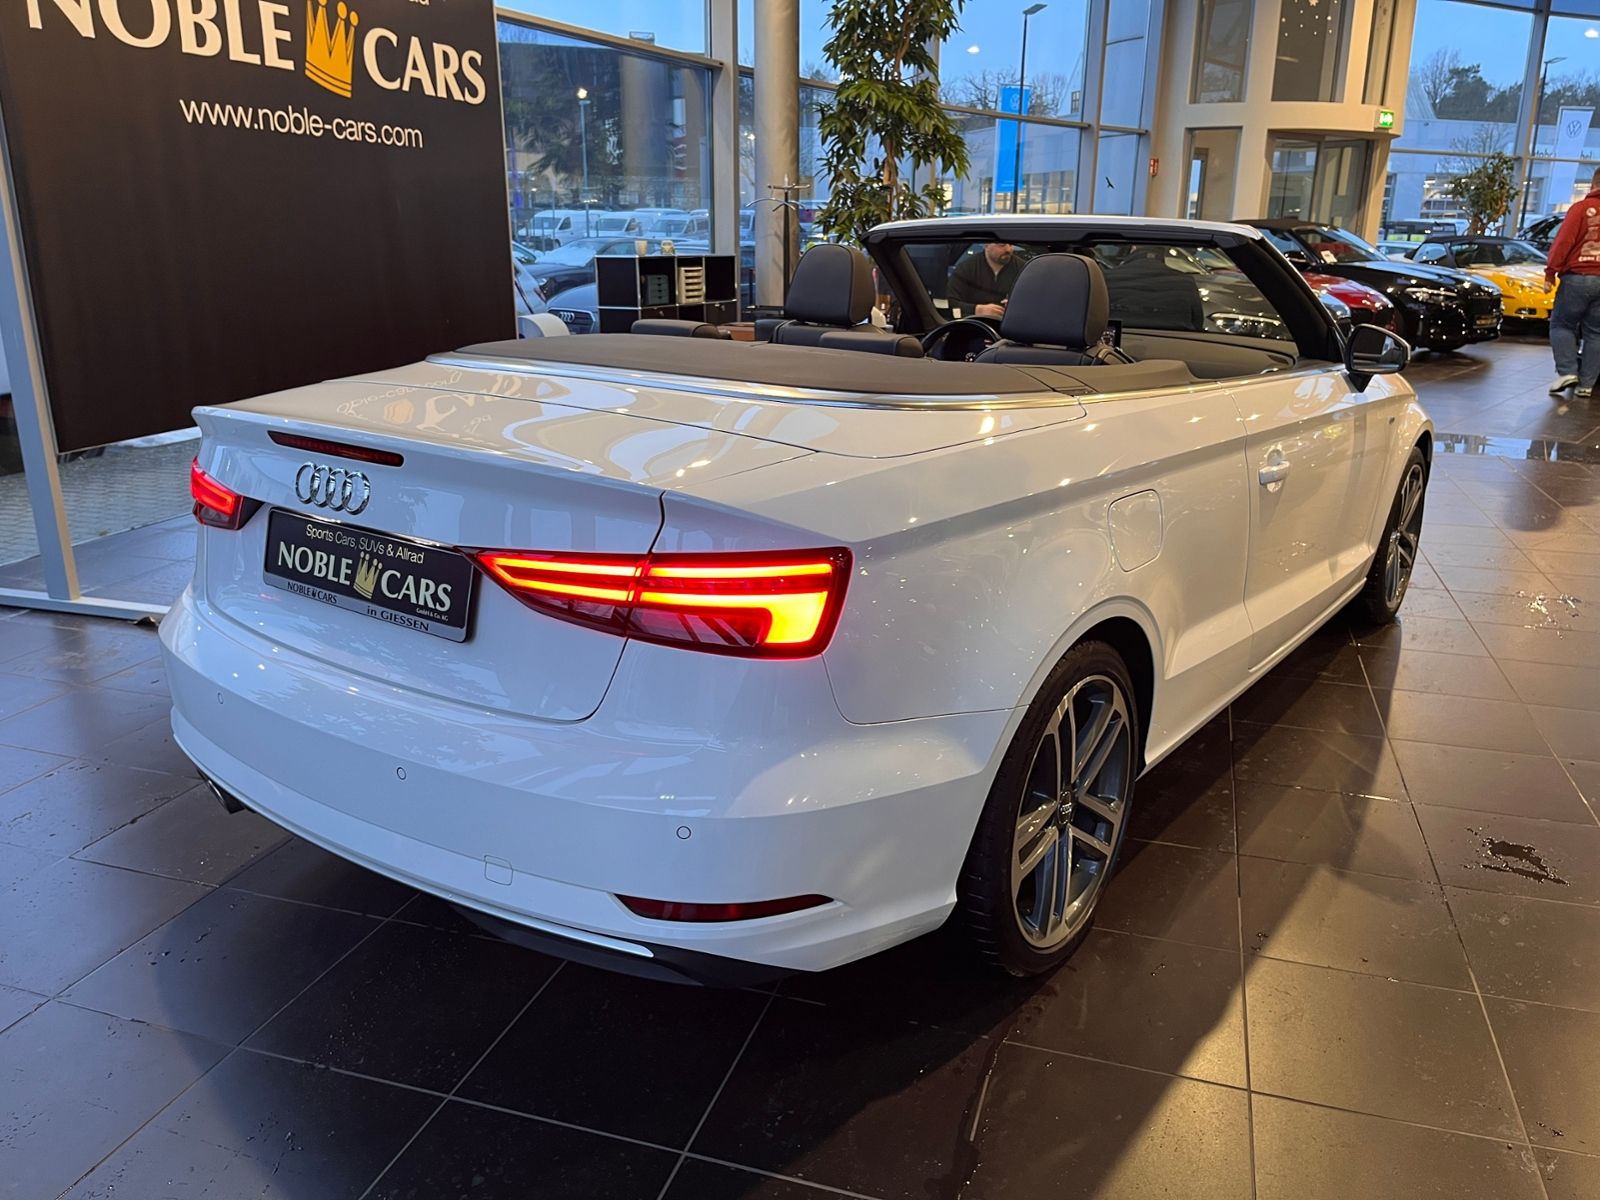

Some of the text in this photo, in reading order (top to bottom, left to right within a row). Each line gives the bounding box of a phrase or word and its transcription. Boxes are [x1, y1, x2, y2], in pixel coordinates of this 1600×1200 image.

[363, 27, 487, 105] CARS
[180, 99, 424, 148] www.noble-cars.com
[306, 524, 424, 564] Sports Cars, SUVs & Allrad
[278, 541, 452, 612] NOBLE CARS
[287, 581, 337, 604] NOBLE CARS
[367, 605, 430, 632] in GIESSEN
